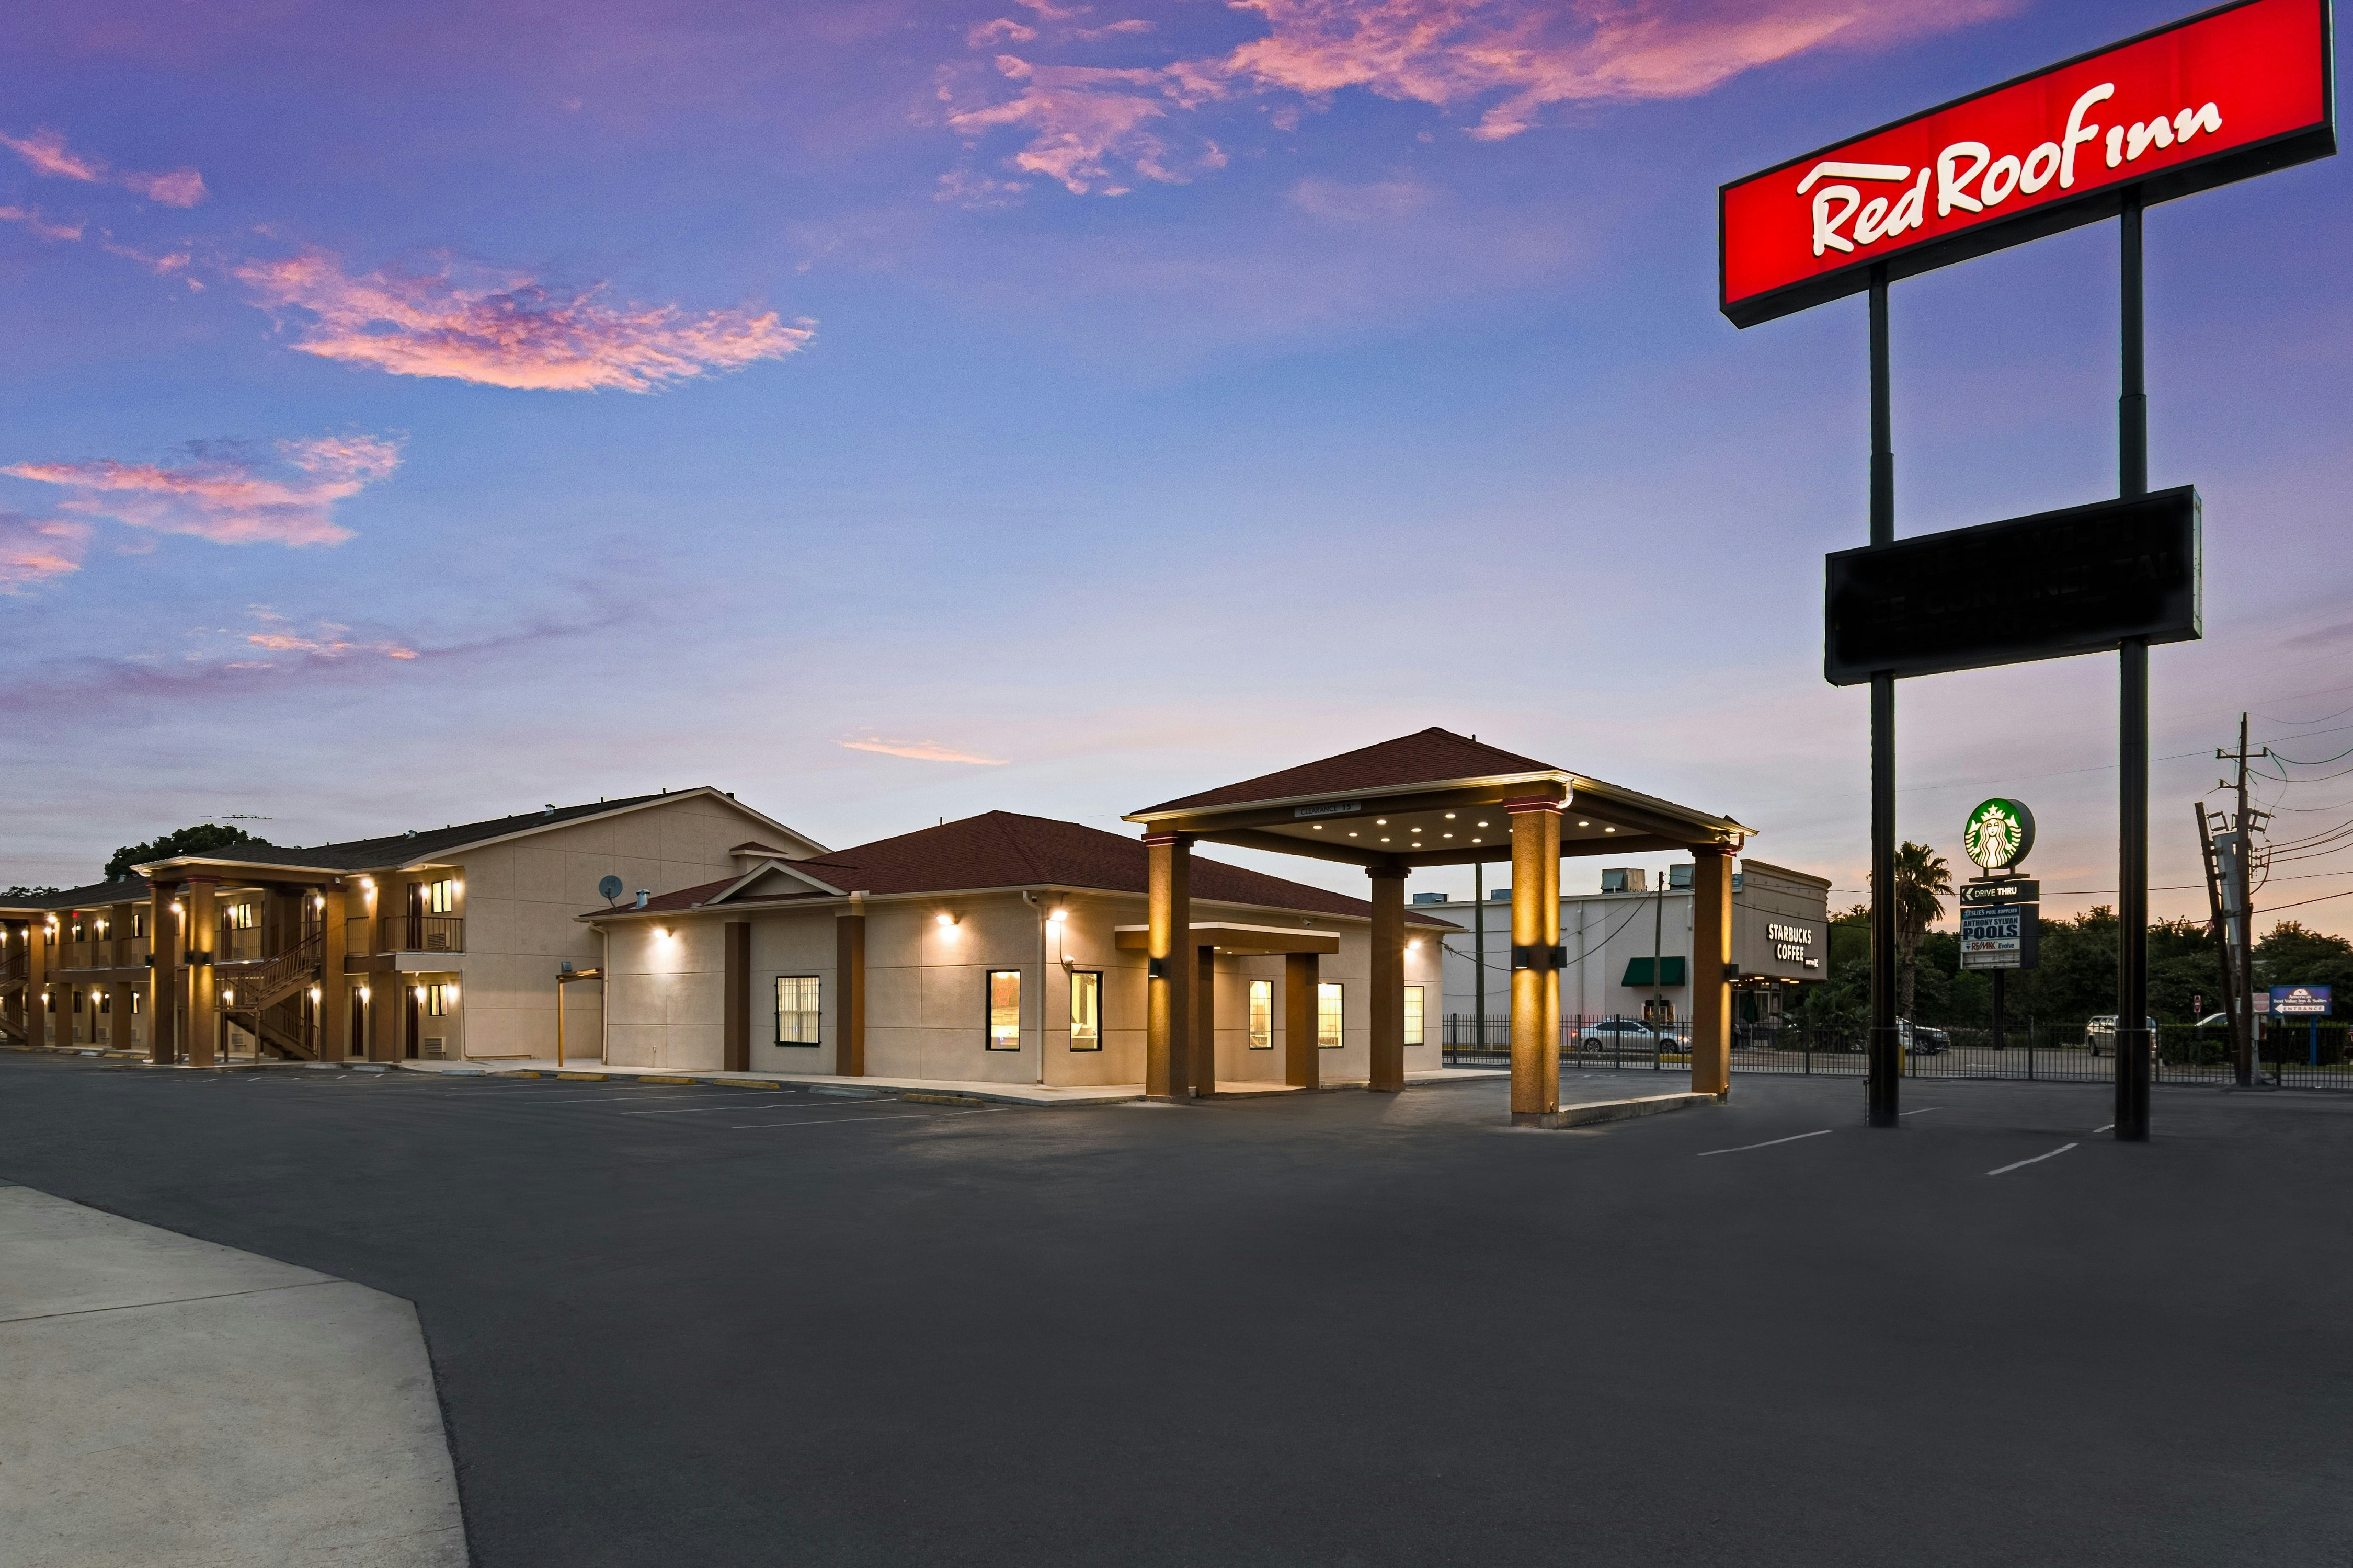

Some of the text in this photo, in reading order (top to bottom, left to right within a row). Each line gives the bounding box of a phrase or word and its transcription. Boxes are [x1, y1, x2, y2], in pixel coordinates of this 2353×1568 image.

[1812, 167, 1931, 256] Red
[1300, 805, 1338, 815] CLEARANCE
[1975, 887, 2017, 897] DRIVE THRU
[1963, 917, 2018, 928] ANTHONY SYLVAN
[1768, 923, 1812, 944] STARBUCKS
[1963, 924, 2018, 940] POOLS
[1777, 943, 1804, 962] COFFEE
[1971, 941, 1996, 951] RE/MAX
